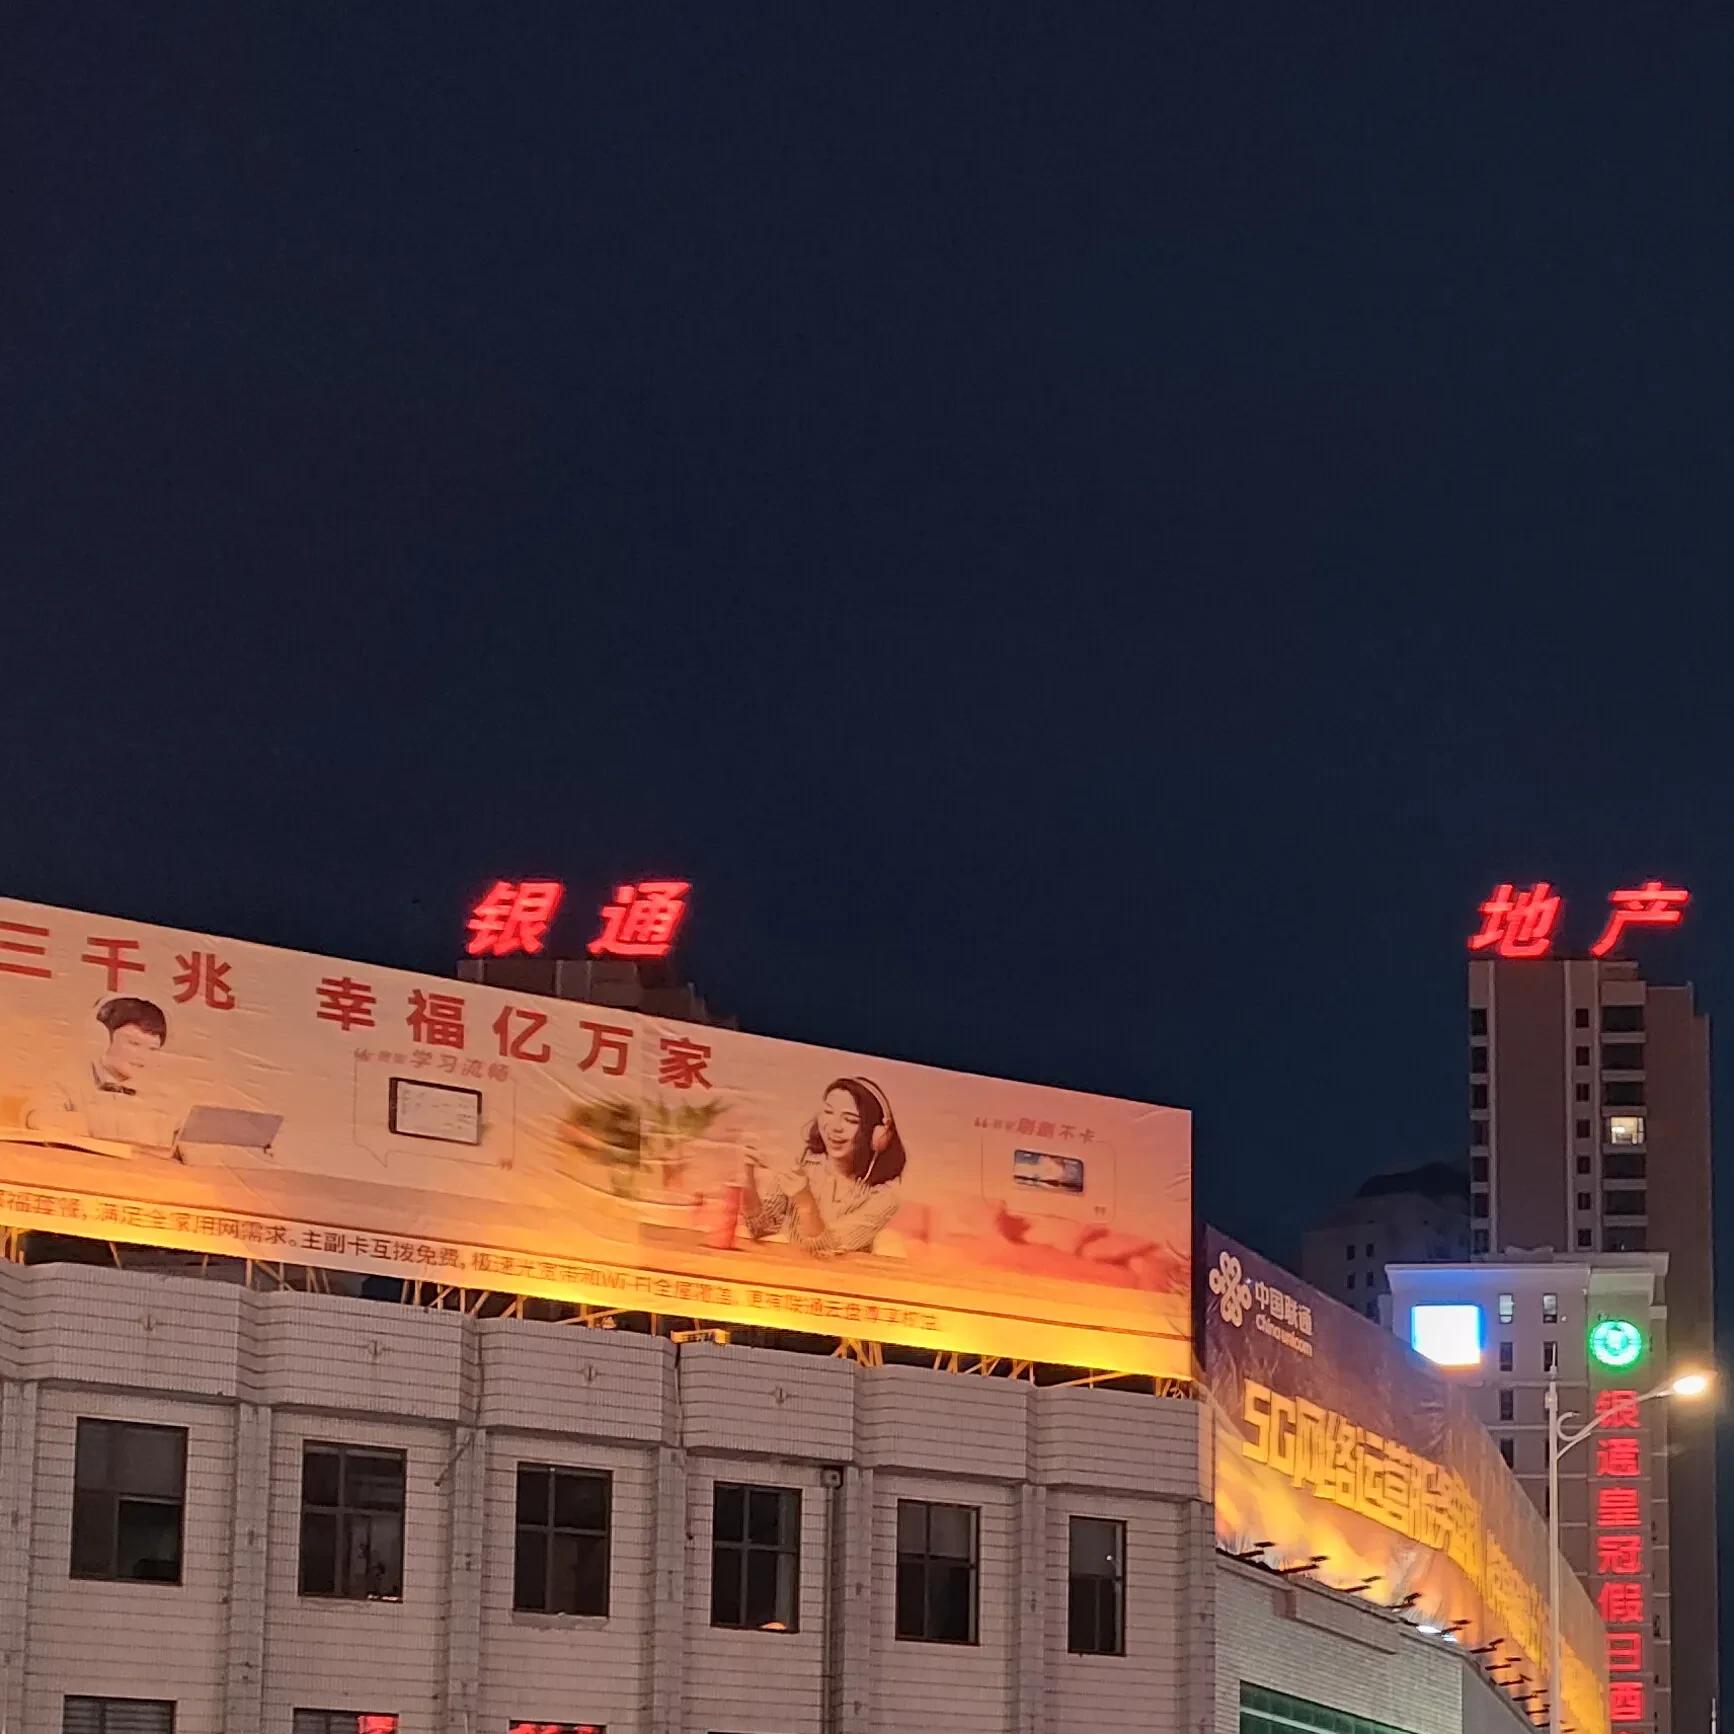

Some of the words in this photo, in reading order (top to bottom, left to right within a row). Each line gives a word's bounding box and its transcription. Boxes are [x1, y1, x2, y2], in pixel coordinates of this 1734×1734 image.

[467, 879, 691, 956] 银通
[1467, 882, 1690, 958] 地产
[316, 976, 712, 1090] 幸福亿万家
[1255, 1281, 1312, 1336] 中国联通
